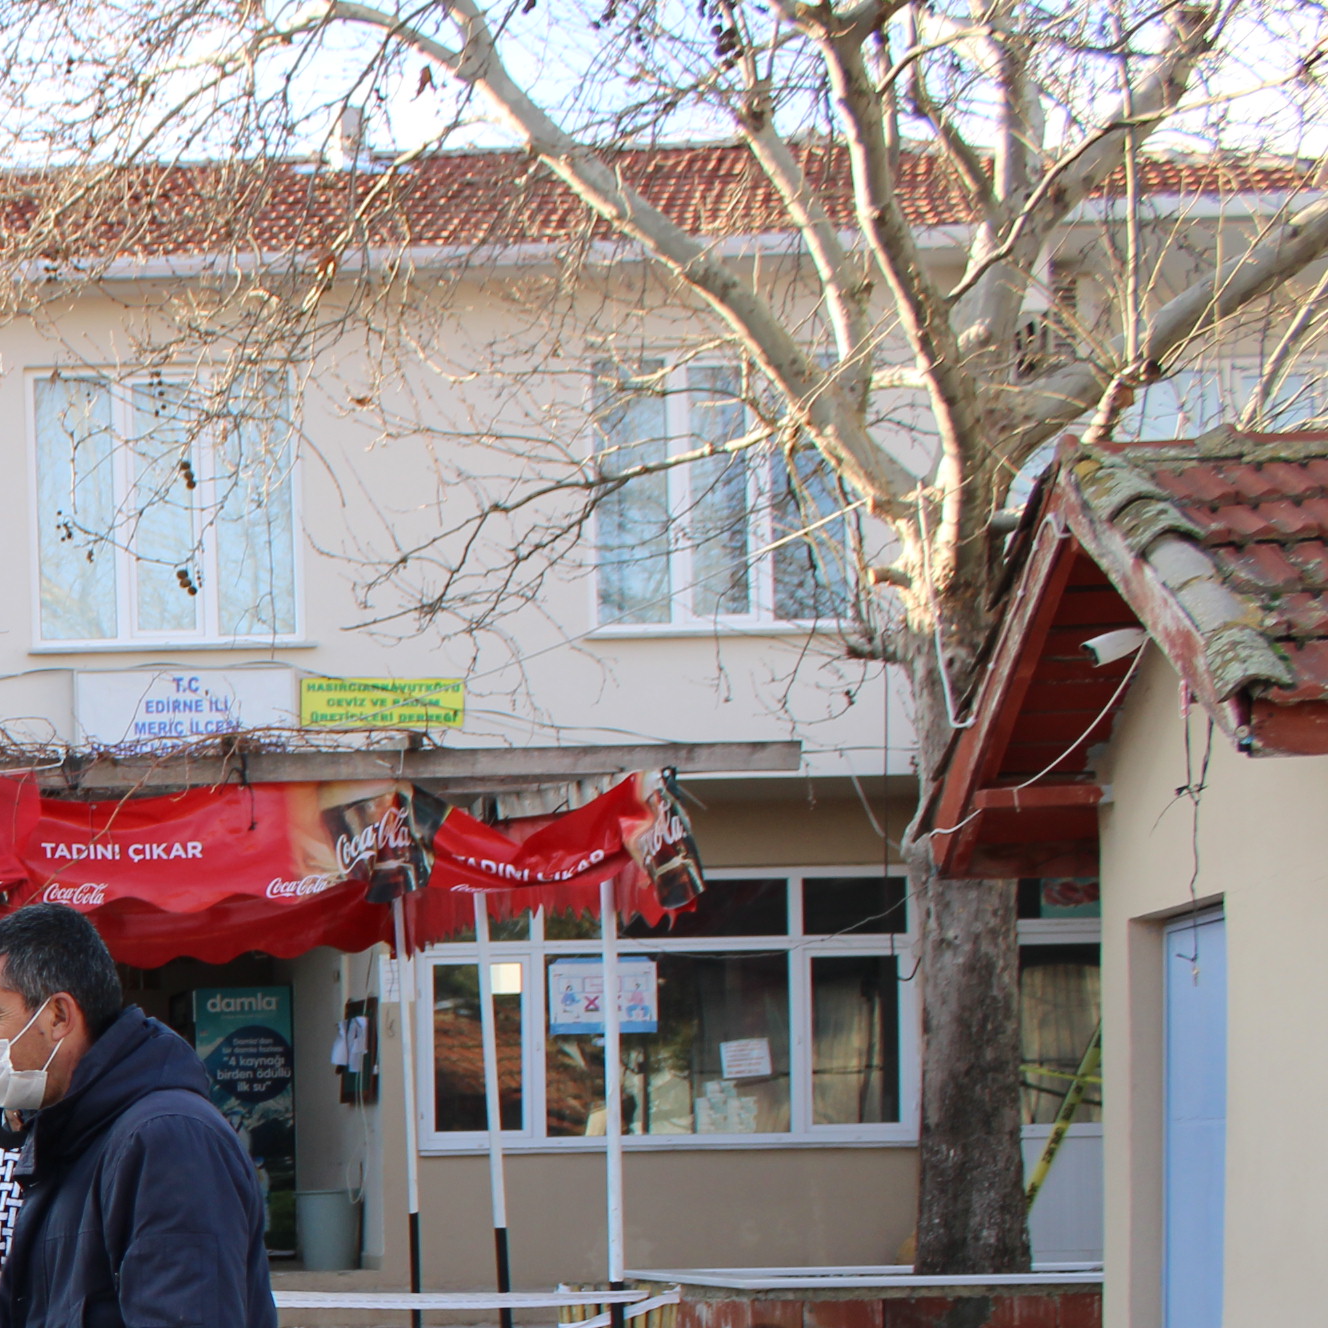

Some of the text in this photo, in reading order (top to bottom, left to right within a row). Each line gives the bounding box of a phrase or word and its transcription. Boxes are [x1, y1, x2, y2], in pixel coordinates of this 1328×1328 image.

[145, 695, 229, 714] EDİRNE İLİ
[327, 695, 366, 707] CEVİZ
[371, 697, 388, 706] VE
[42, 840, 203, 863] TADINI ÇIKAR
[43, 882, 110, 905] Coca-Cola
[265, 873, 330, 899] Coca-Cola
[206, 992, 279, 1013] damla
[216, 1065, 292, 1081] birden ödüllü
[236, 1080, 250, 1093] ilk
